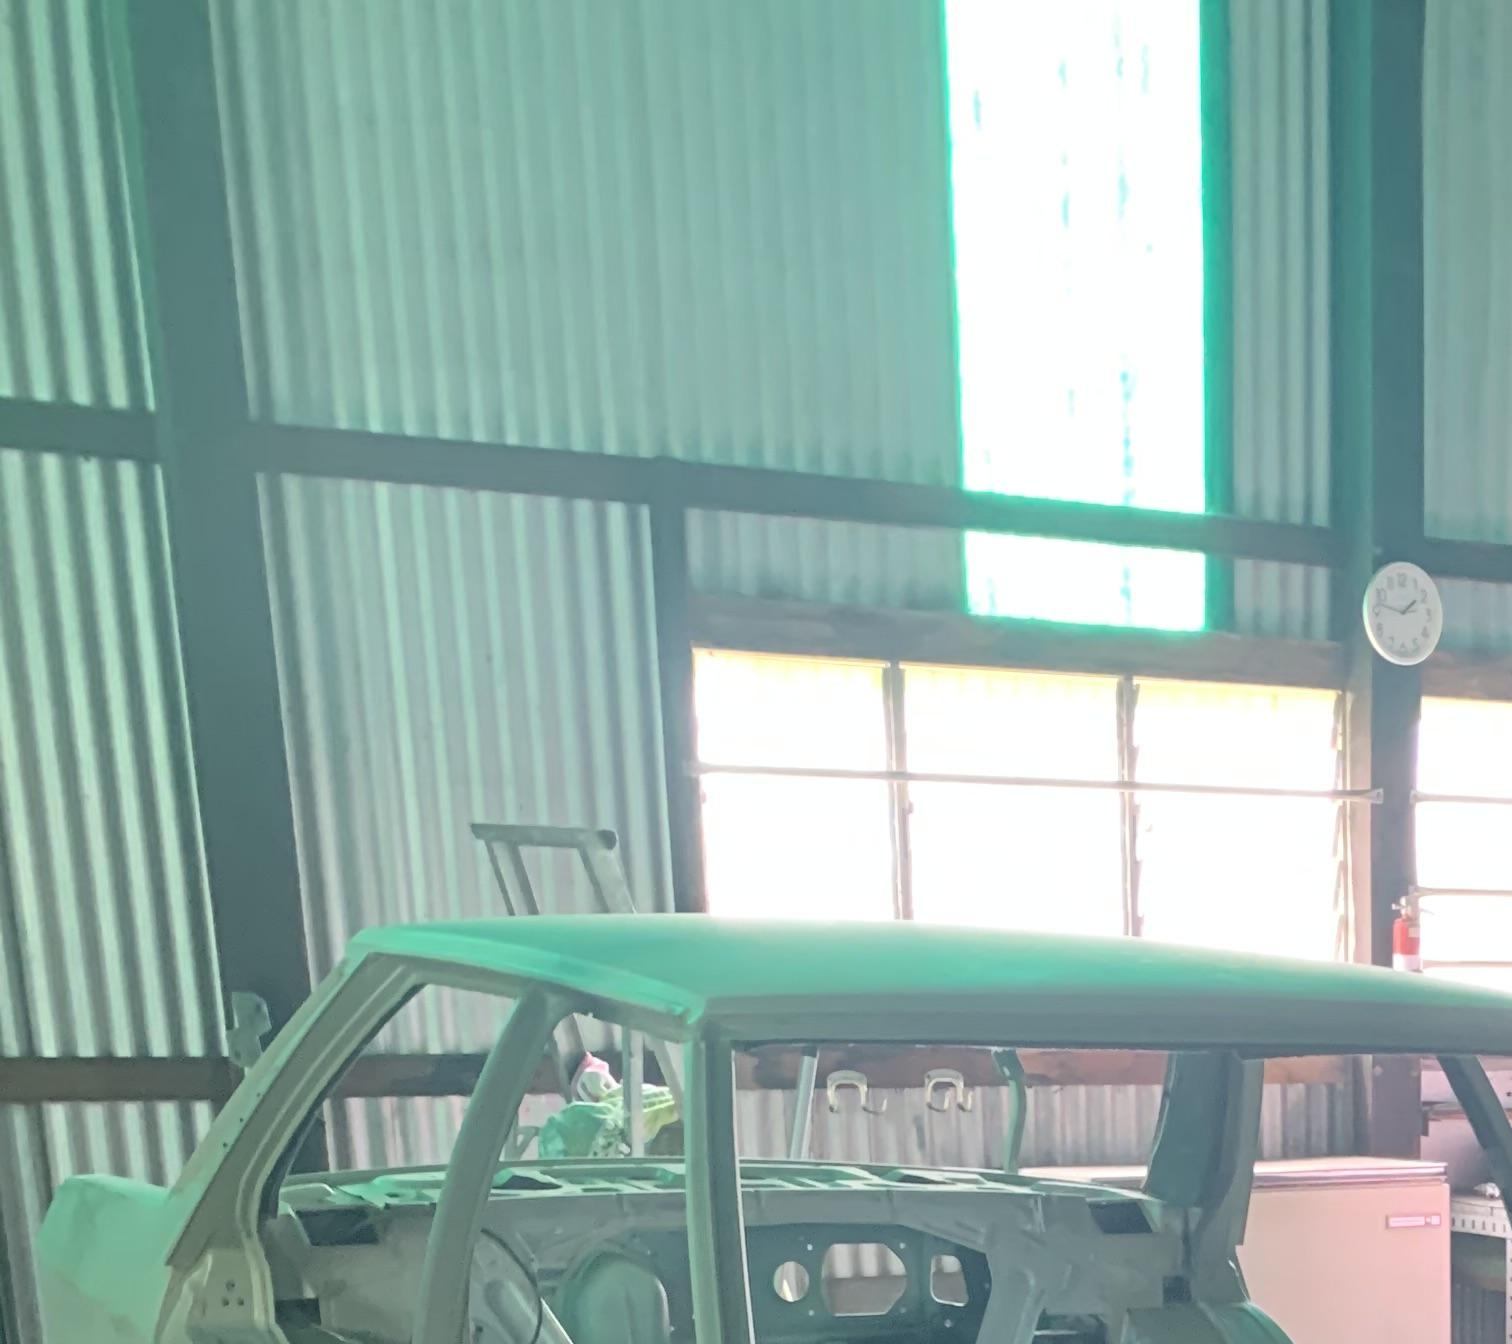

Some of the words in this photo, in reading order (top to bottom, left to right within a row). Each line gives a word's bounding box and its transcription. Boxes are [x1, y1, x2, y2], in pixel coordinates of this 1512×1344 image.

[1396, 572, 1407, 588] 12
[1420, 589, 1428, 604] 2
[1421, 625, 1430, 638] 4
